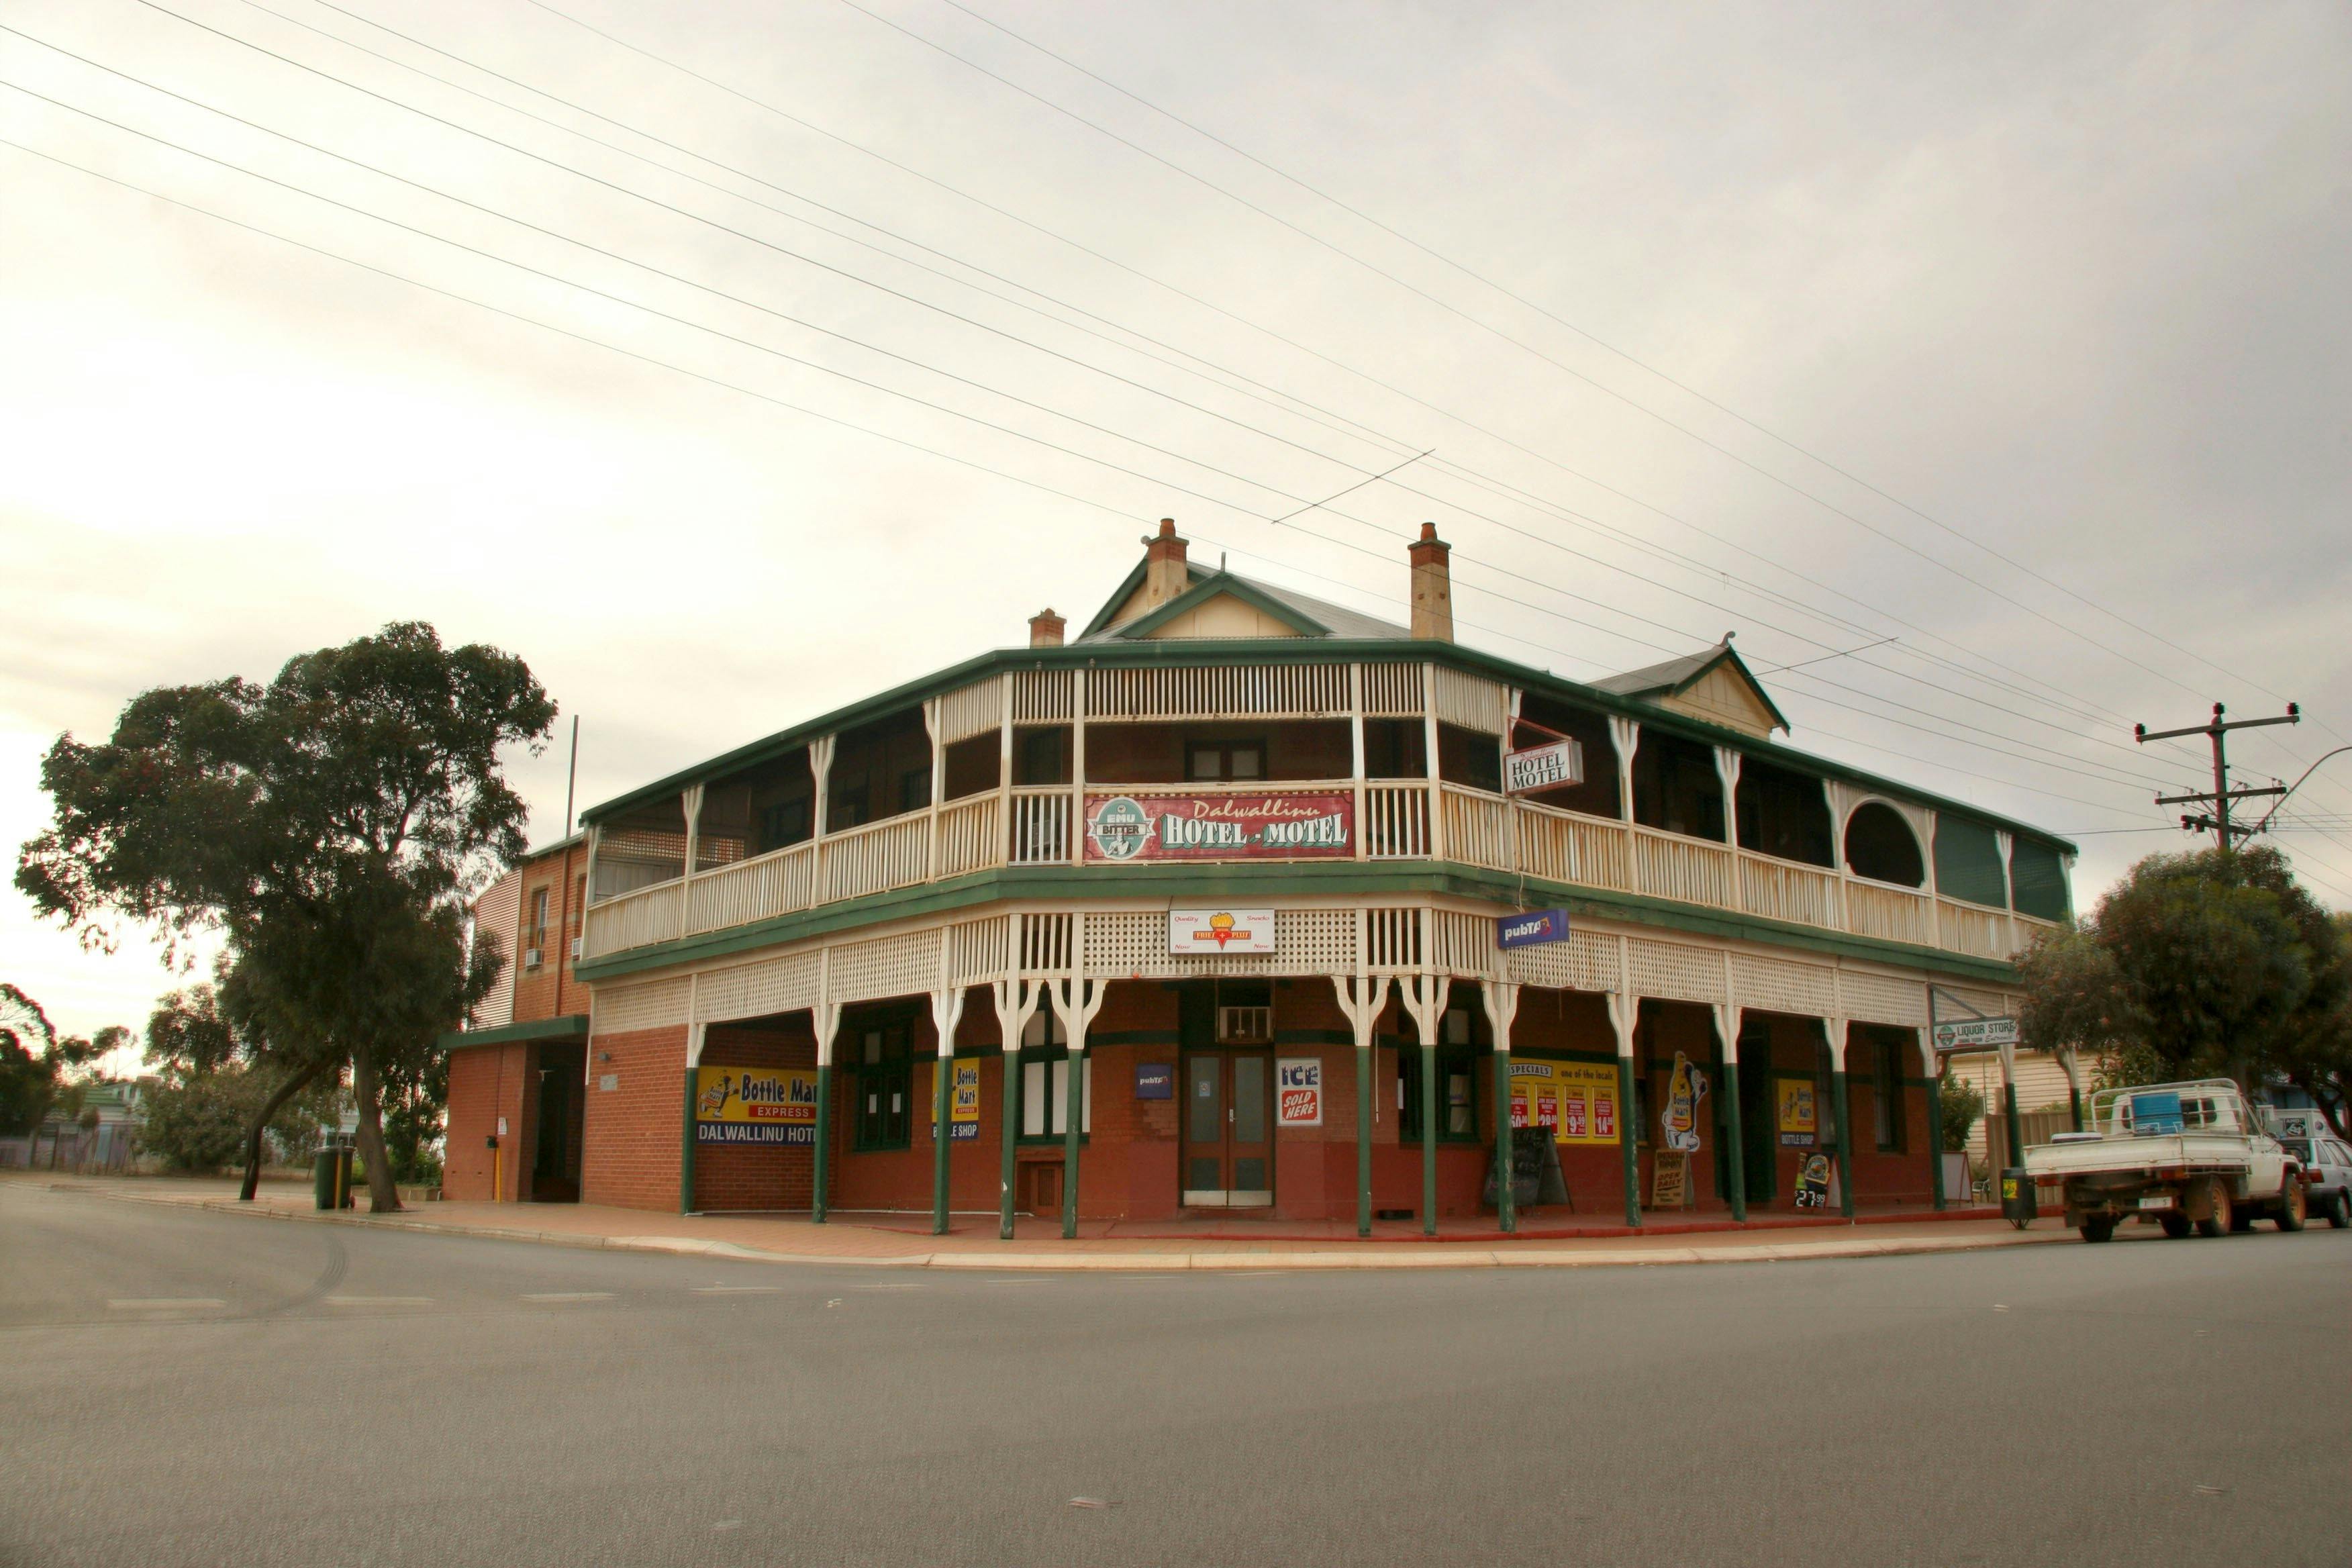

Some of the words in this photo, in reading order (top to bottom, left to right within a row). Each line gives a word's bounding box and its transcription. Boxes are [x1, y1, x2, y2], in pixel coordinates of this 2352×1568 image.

[1512, 752, 1565, 776] HOTEL
[1512, 767, 1567, 789] MOTEL
[1193, 799, 1320, 818] Dalwallinu
[1107, 814, 1136, 823] EMU
[1103, 825, 1139, 834] BITTER
[1163, 813, 1247, 844] HOTEL
[1267, 812, 1347, 844] MOTEL
[1174, 916, 1198, 924] Quality
[1957, 1024, 1986, 1037] LIQUOR
[1988, 1021, 2014, 1033] STORE
[957, 1068, 977, 1085] Bottle
[1281, 1065, 1318, 1086] ICE
[1511, 1065, 1549, 1075] SPECIALS
[1575, 1069, 1581, 1079] of
[1583, 1069, 1594, 1079] the
[1596, 1069, 1613, 1080] locals
[741, 1074, 785, 1102] Bottle
[790, 1079, 816, 1103] Mar
[958, 1089, 975, 1104] Mart
[1284, 1091, 1311, 1107] SOLD
[758, 1107, 809, 1117] EXPRESS
[1286, 1102, 1315, 1119] HERE
[699, 1124, 783, 1141] DALWALLINU
[789, 1127, 816, 1142] HOT
[959, 1124, 977, 1137] SHOP
[1781, 1135, 1800, 1144] BOTTLE
[1657, 1178, 1682, 1187] DAILY
[1658, 1172, 1681, 1181] OPEN
